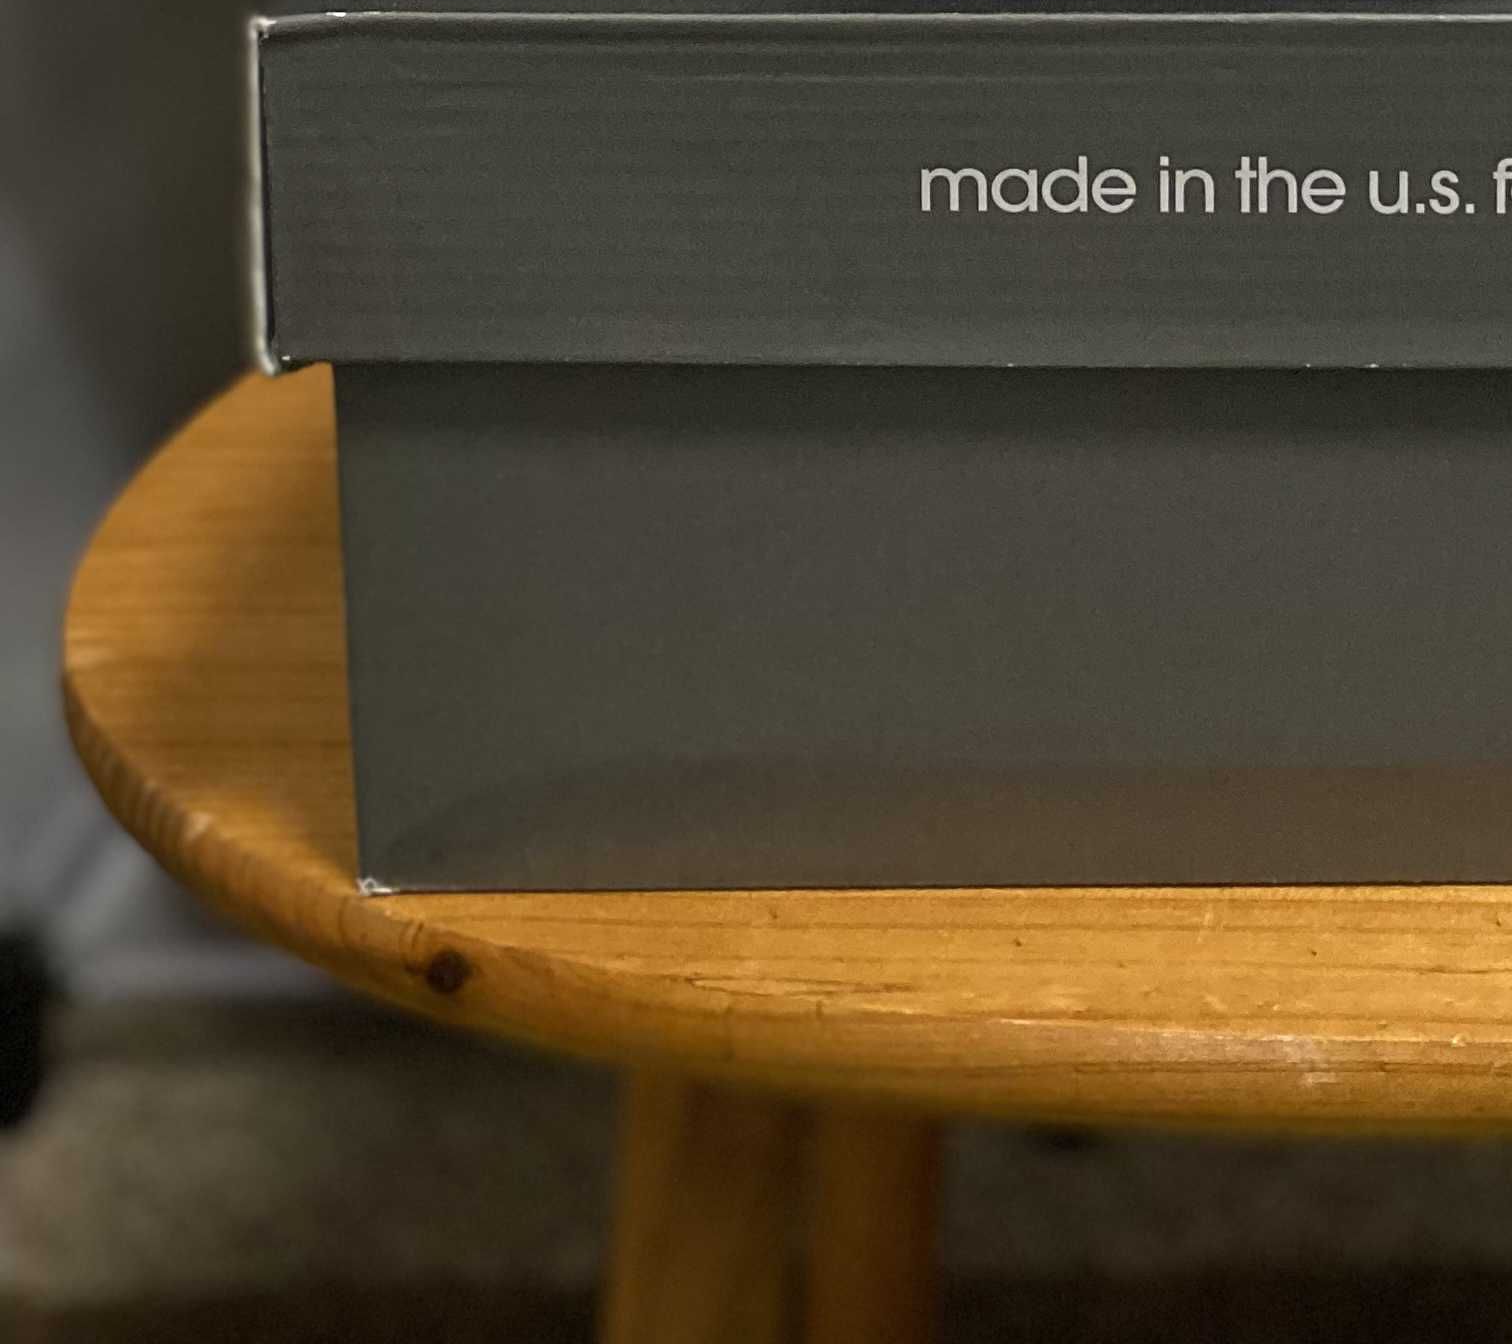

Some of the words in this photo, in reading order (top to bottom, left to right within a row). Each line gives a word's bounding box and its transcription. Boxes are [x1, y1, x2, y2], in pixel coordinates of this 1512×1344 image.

[921, 155, 1137, 214] made
[1159, 155, 1215, 214] in
[1234, 156, 1347, 215] the
[1369, 170, 1475, 215] u.s.
